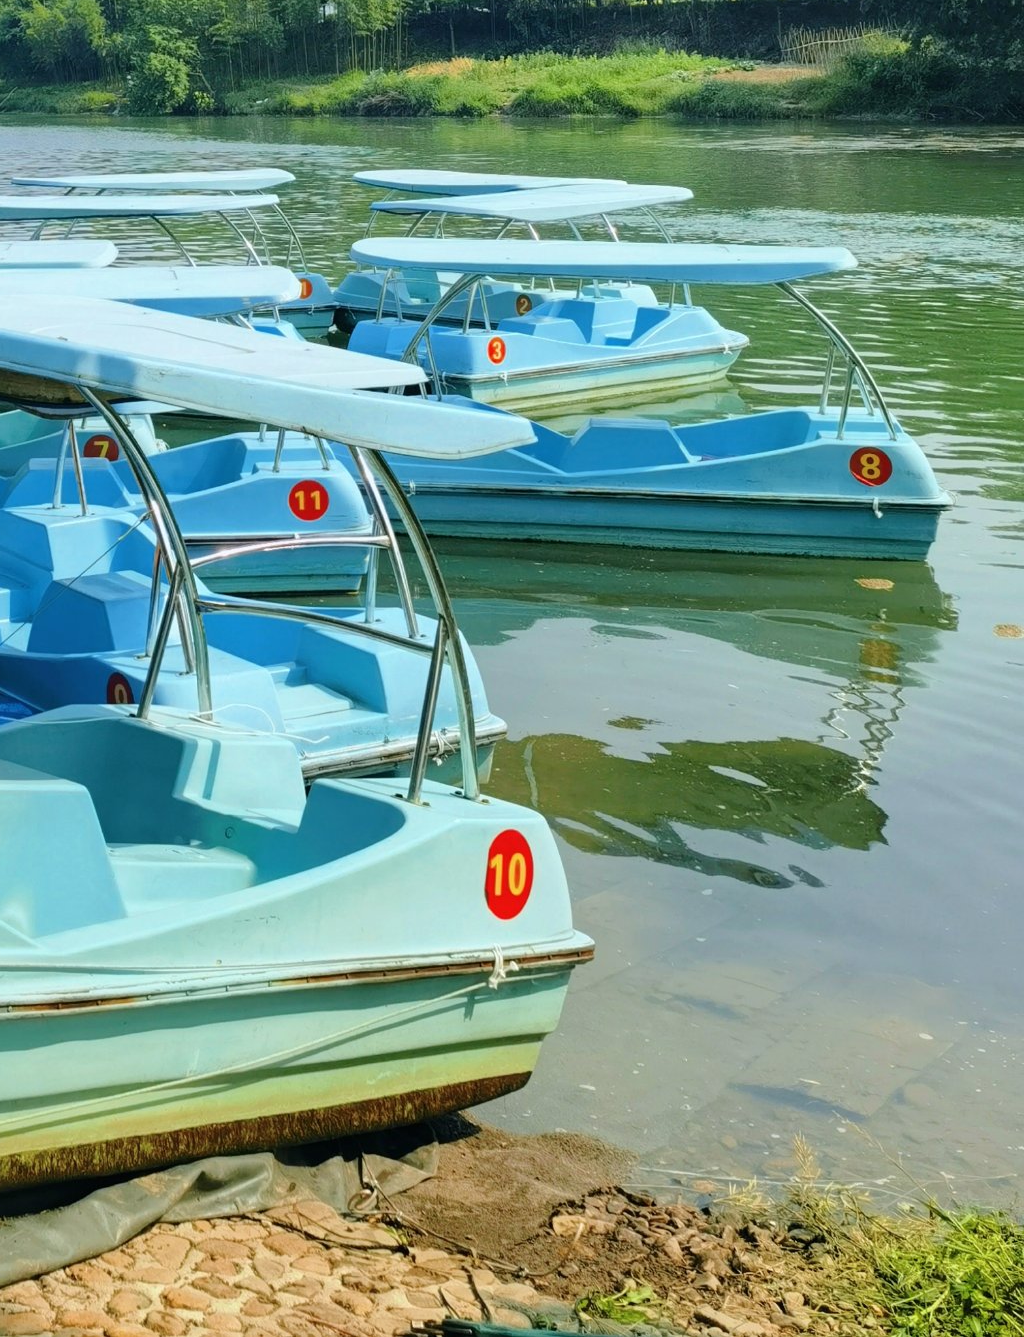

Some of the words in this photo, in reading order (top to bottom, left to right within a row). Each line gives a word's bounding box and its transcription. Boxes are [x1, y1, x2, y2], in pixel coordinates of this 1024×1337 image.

[520, 298, 529, 314] 2
[492, 341, 502, 360] 3
[94, 440, 109, 458] 7
[860, 453, 881, 480] 8
[294, 490, 321, 511] 11
[490, 852, 527, 896] 10
